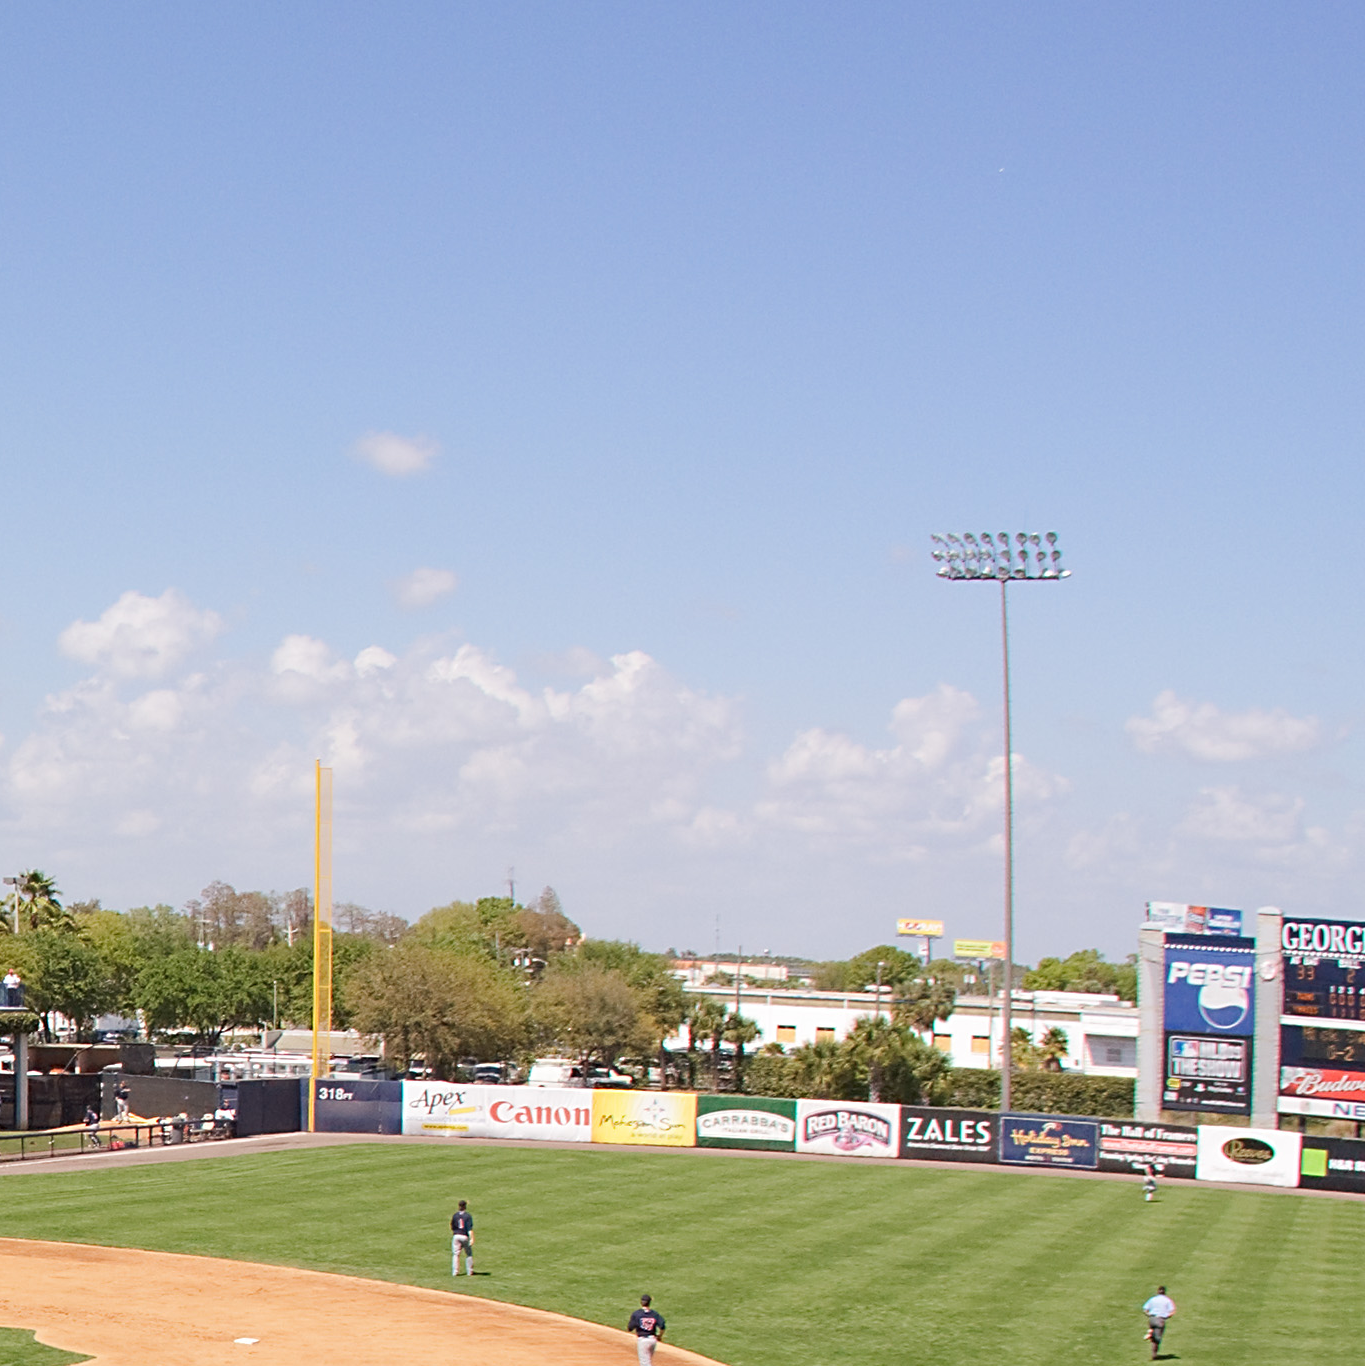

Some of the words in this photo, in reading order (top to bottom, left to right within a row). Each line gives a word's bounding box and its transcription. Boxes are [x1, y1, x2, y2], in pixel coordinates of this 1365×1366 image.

[1281, 922, 1365, 954] GEORG
[1167, 961, 1253, 989] PEPSI
[409, 1089, 466, 1114] Apex
[489, 1101, 590, 1126] Canon
[702, 1114, 789, 1133] CARRABBA'S
[807, 1113, 835, 1132] RED
[836, 1111, 889, 1137] BARON
[906, 1117, 992, 1144] ZALES
[1010, 1129, 1061, 1149] Holiday
